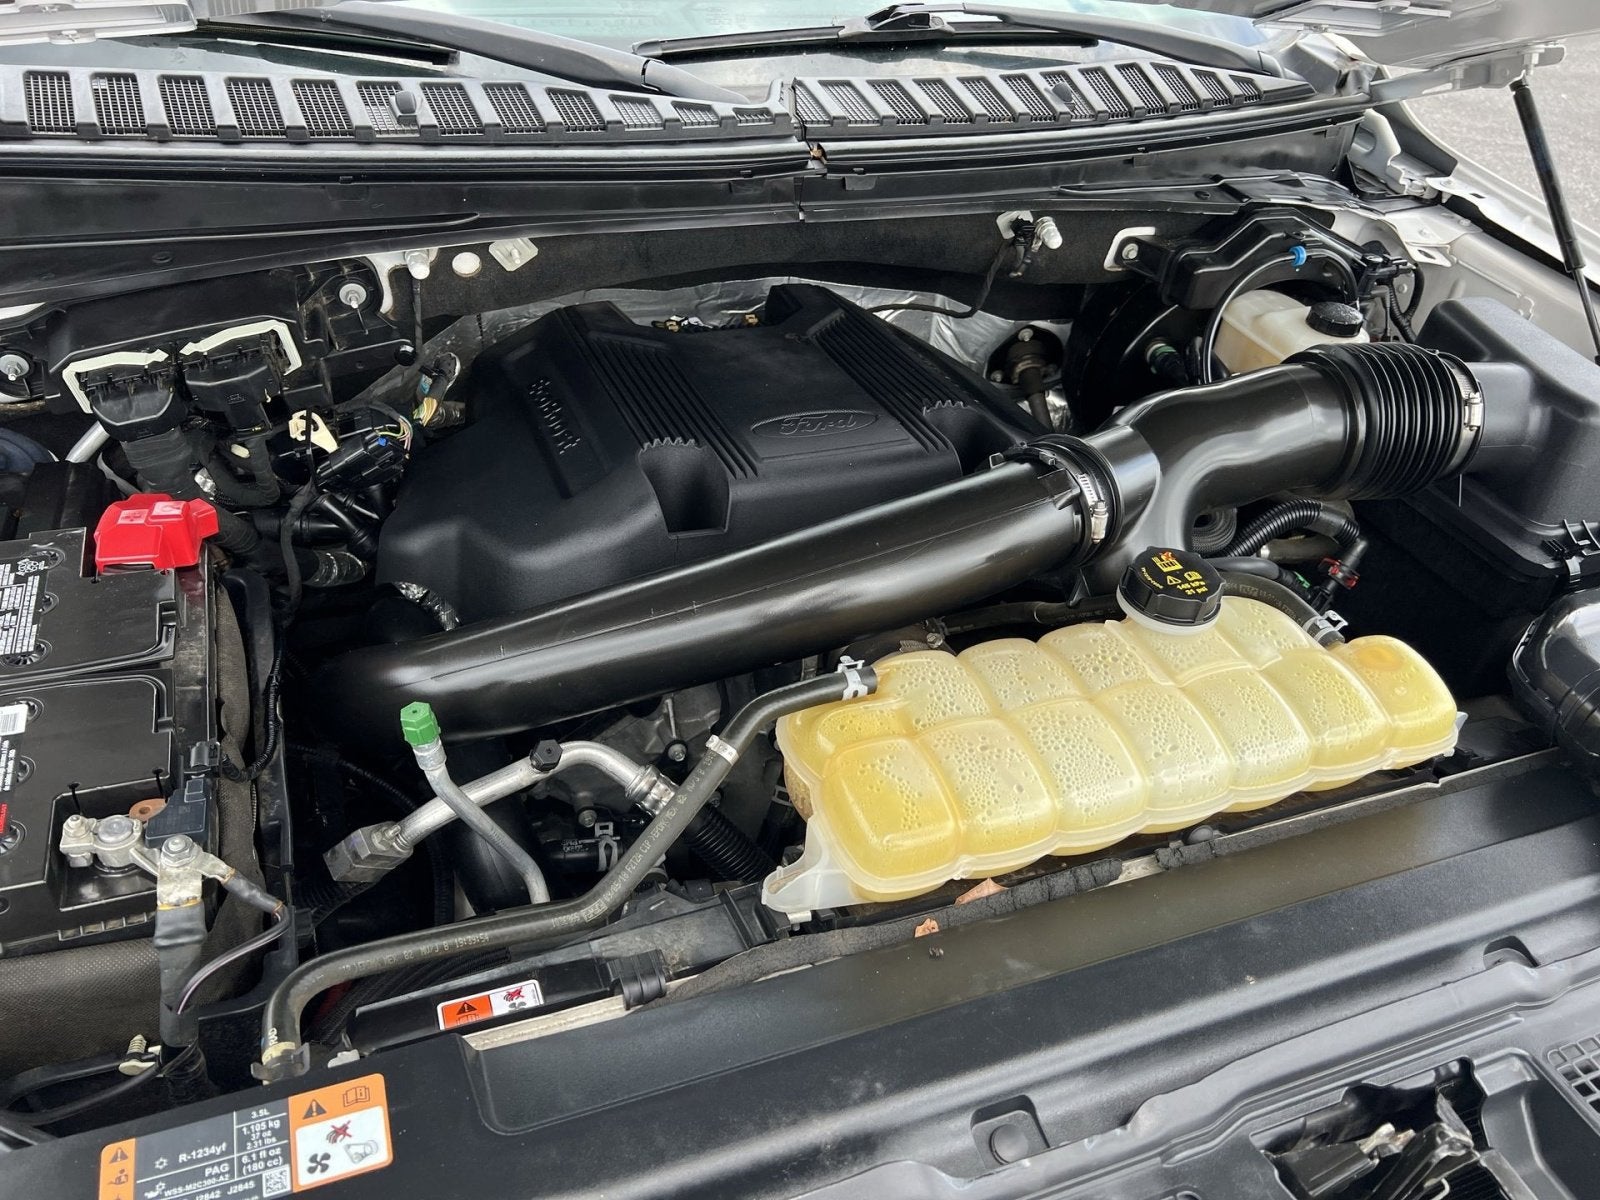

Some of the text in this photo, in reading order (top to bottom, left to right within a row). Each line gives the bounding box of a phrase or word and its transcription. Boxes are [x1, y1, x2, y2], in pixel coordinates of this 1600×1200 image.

[779, 413, 858, 436] Ford
[251, 1107, 270, 1119] 3.5L
[242, 1119, 281, 1136] 1.105 kg
[251, 1132, 260, 1141] 37
[264, 1136, 277, 1145] lbs
[178, 1142, 227, 1163] R-1234yf
[241, 1147, 281, 1164] 6.1 fl oz
[205, 1163, 230, 1177] PAG
[242, 1155, 283, 1175] (180 cc)
[227, 1180, 255, 1195] J2845
